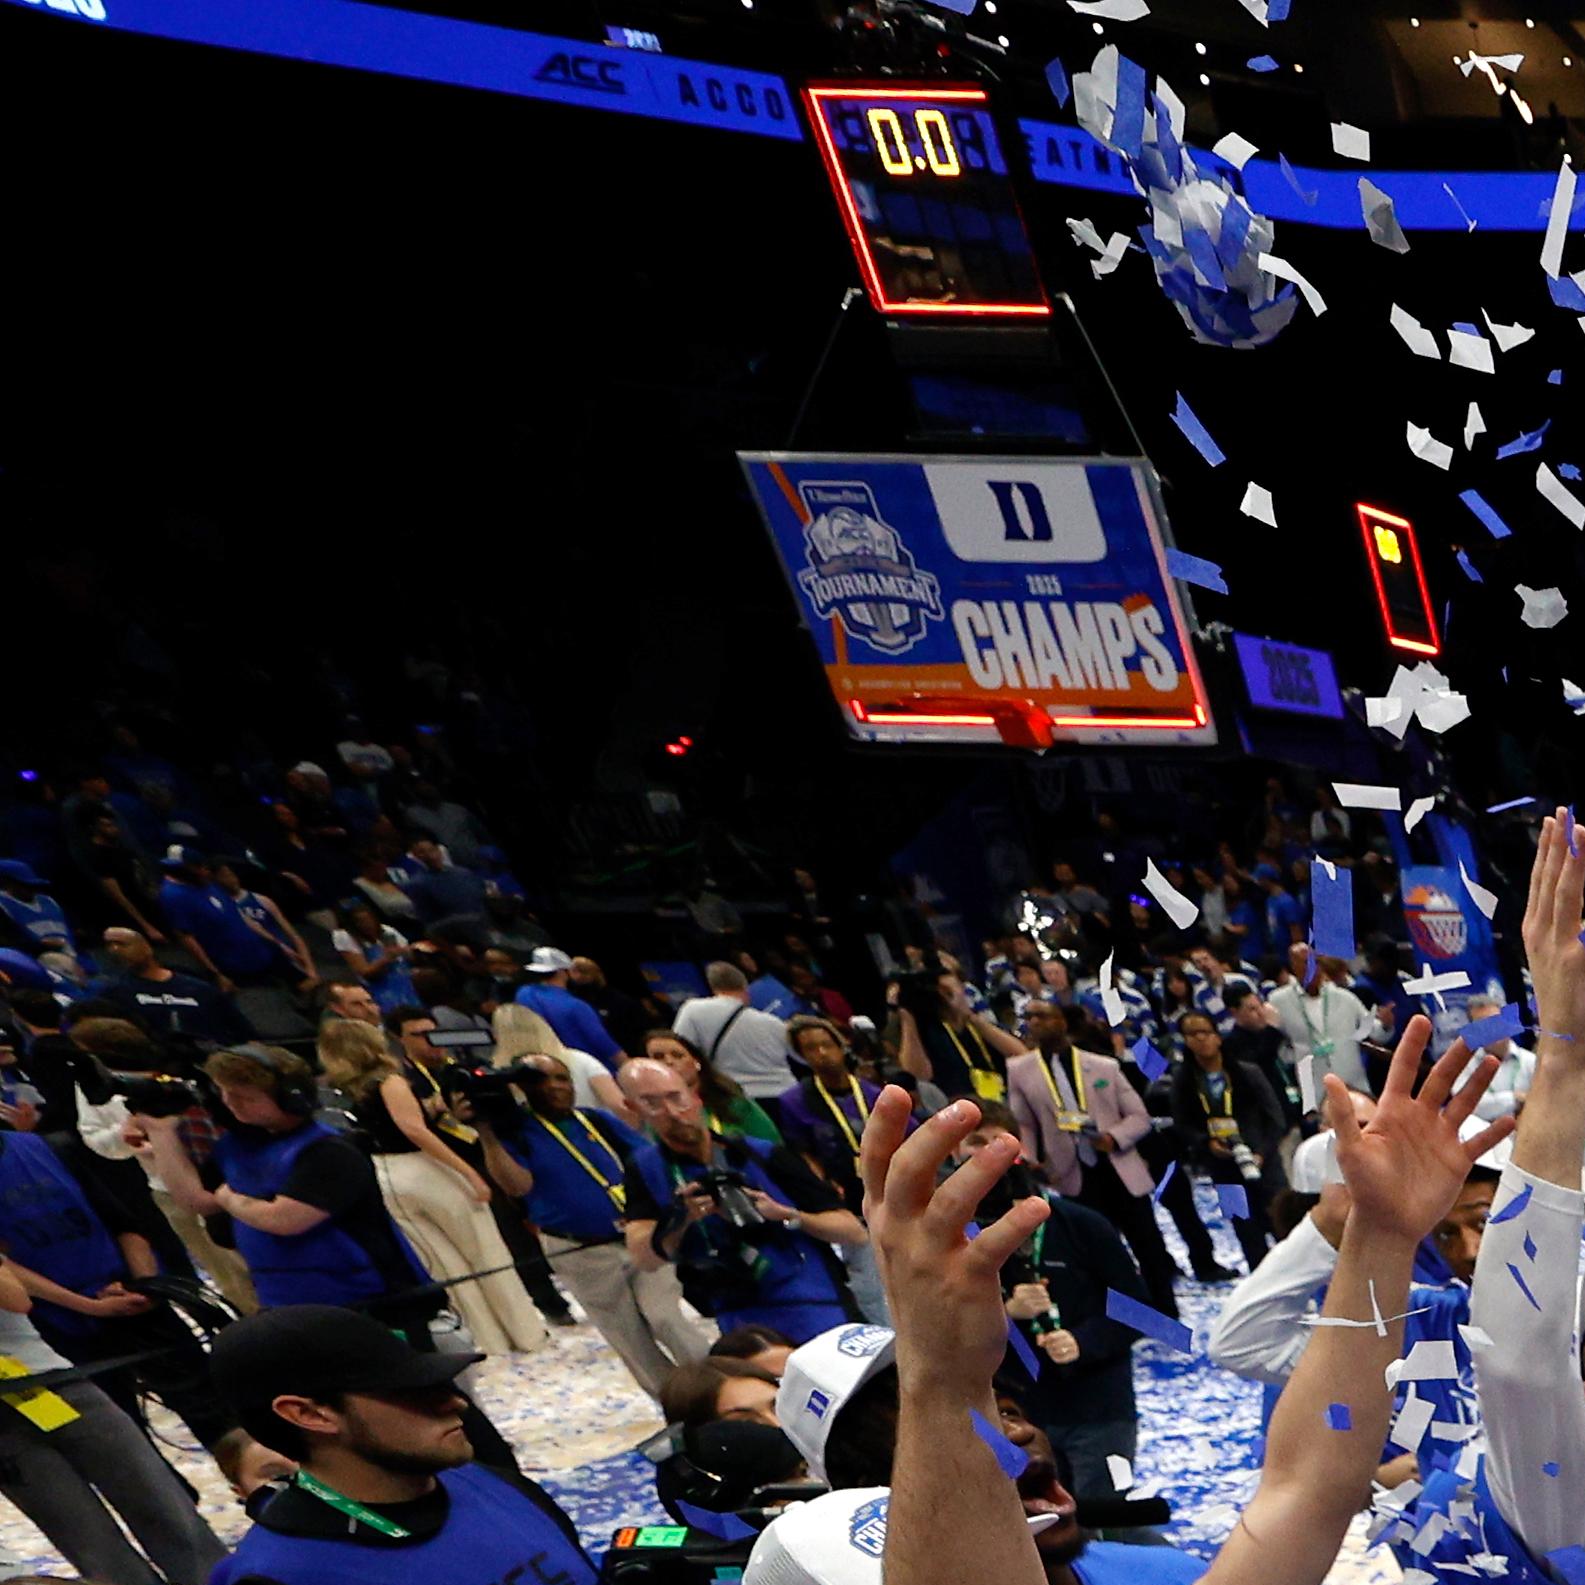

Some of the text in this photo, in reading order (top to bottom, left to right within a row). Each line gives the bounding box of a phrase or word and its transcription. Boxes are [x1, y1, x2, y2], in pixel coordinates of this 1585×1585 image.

[533, 53, 626, 95] ACC
[867, 107, 961, 176] 0.0
[986, 481, 1053, 541] D
[805, 572, 941, 611] TOURNAMENT
[951, 599, 1179, 692] CHAMPS
